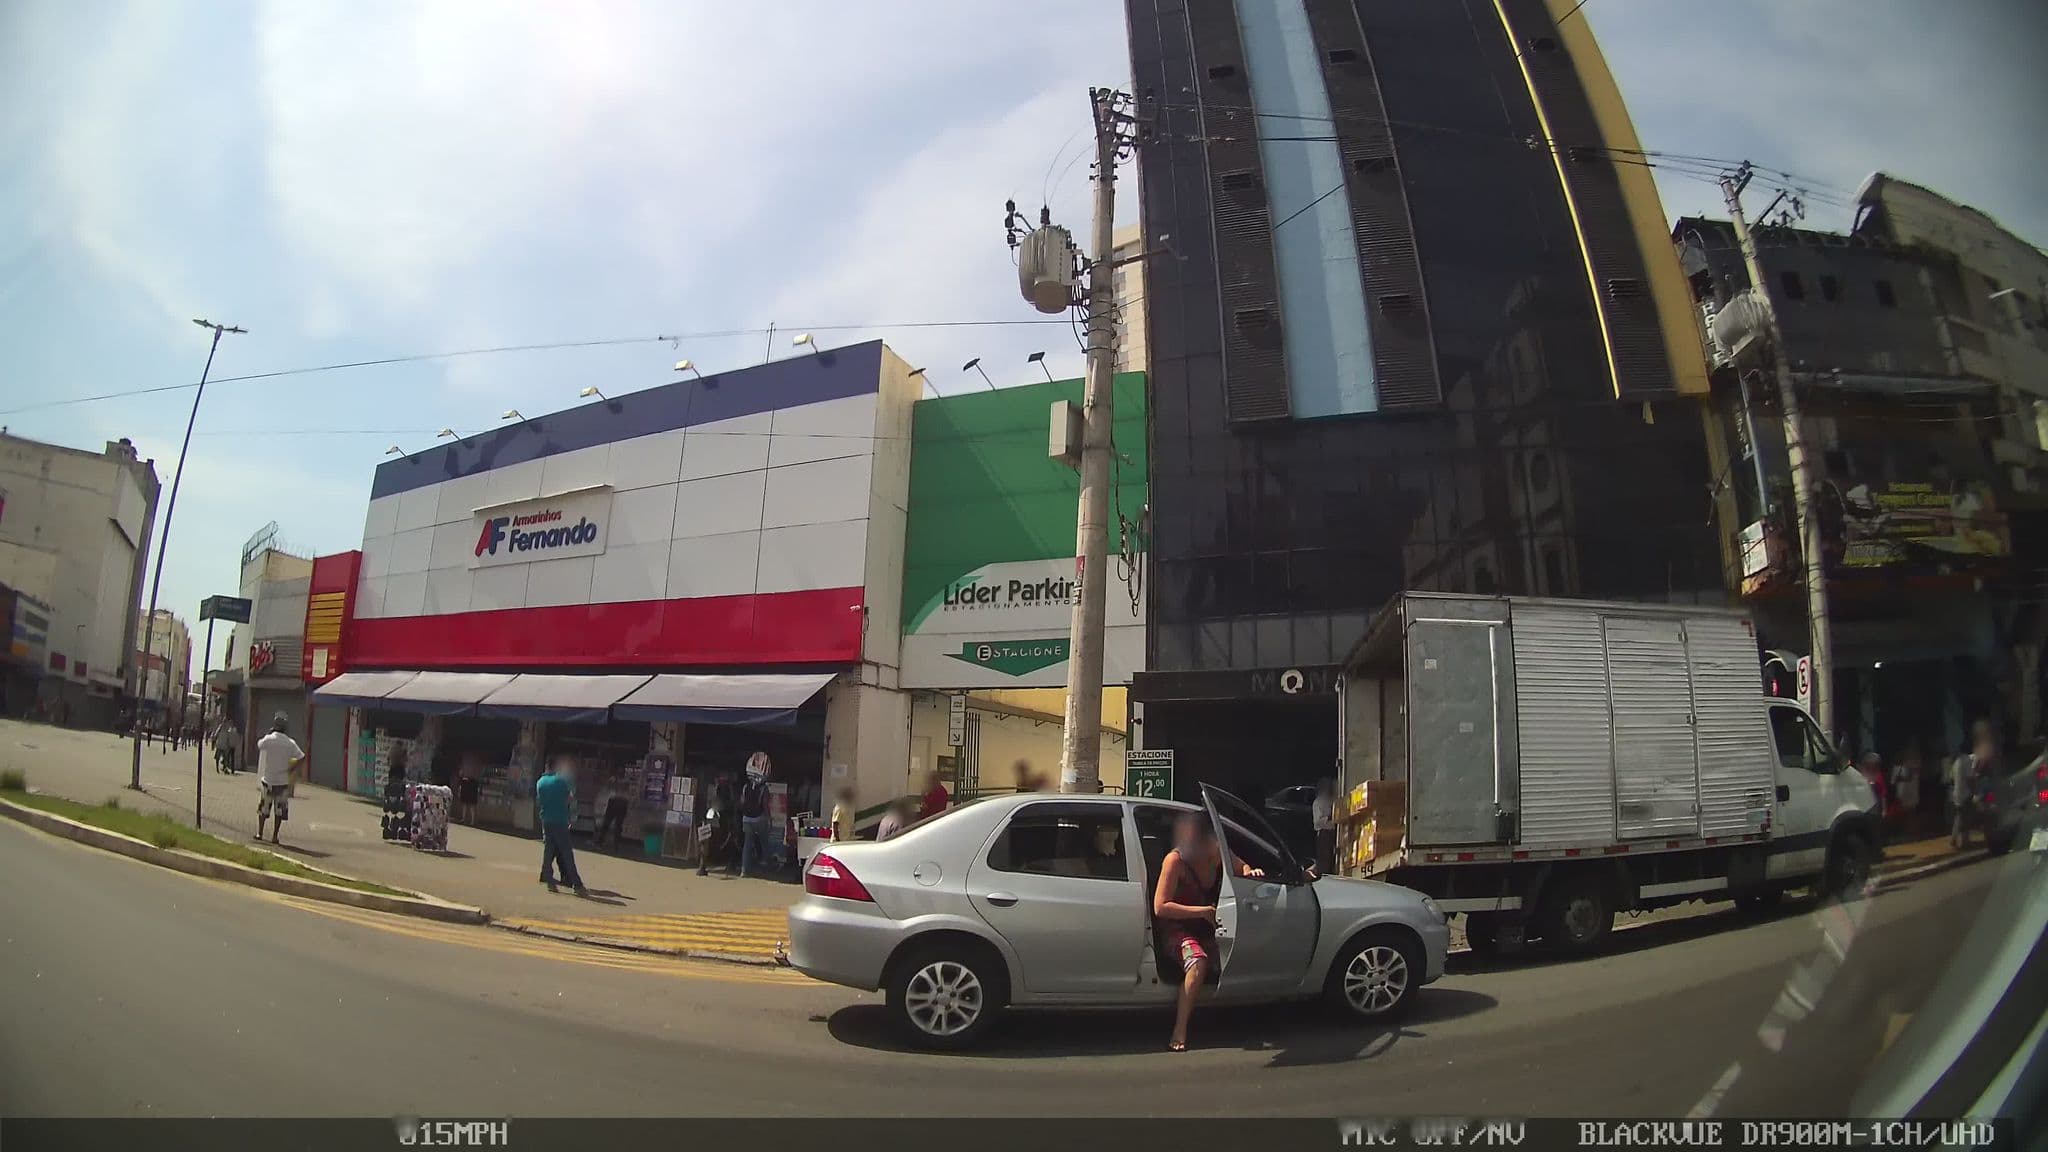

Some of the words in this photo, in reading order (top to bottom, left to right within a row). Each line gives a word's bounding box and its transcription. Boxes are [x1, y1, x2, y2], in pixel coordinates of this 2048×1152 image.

[513, 509, 562, 527] Armarinhos
[475, 517, 510, 557] AF
[509, 516, 597, 553] Fernando
[1009, 576, 1075, 602] Parkin
